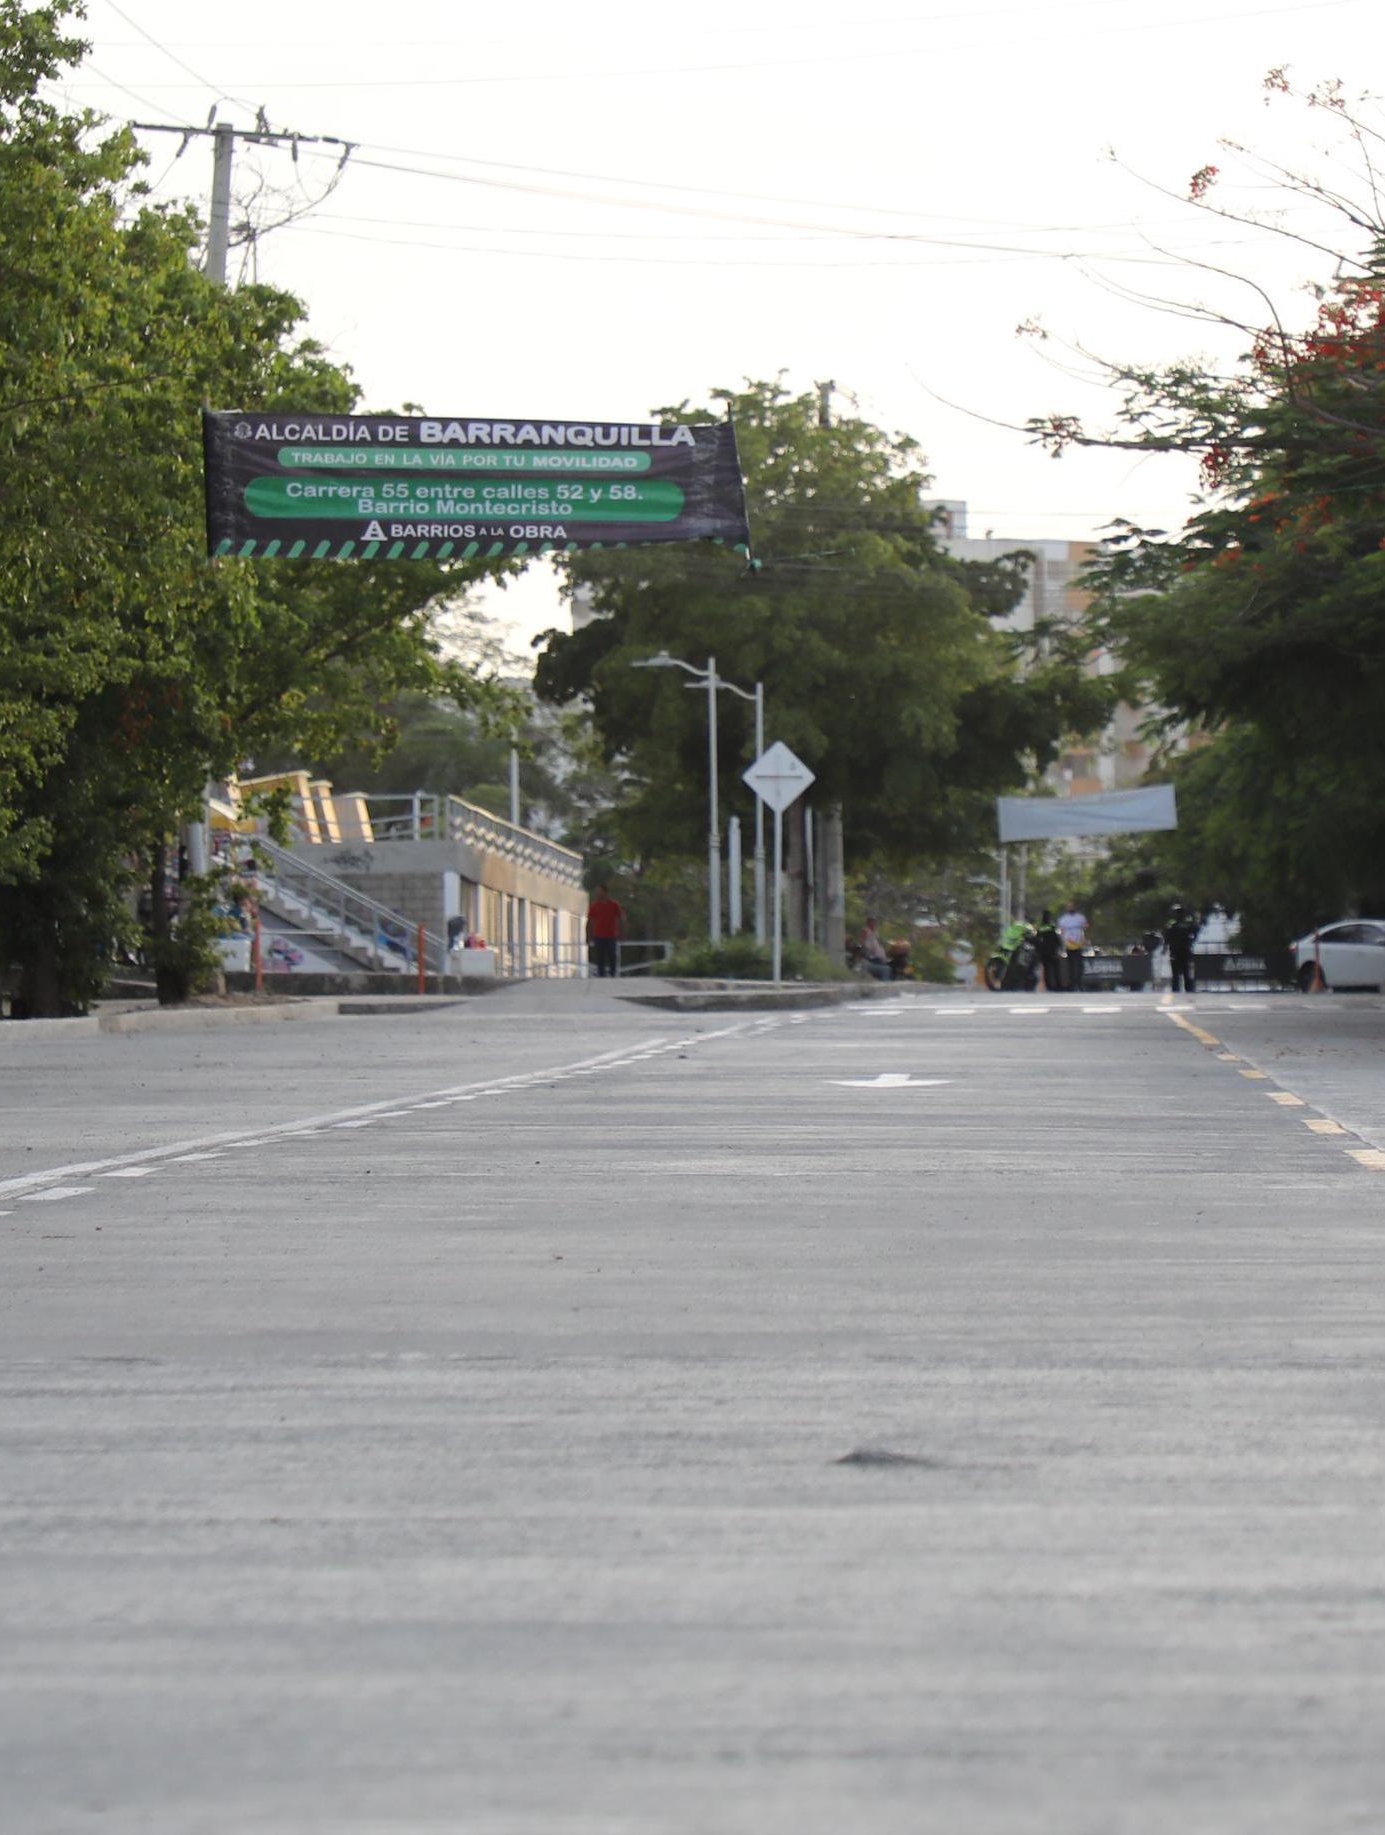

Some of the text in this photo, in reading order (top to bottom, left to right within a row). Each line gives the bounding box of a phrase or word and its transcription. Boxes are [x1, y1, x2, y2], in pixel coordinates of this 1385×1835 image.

[255, 421, 696, 447] ALCALDÍA DE BARRANQUILLA
[292, 451, 638, 468] TRABAJO EN LA VÍA POR TU MOVILIDAD
[286, 482, 643, 503] Carrera 55 entre calles 52 y 58.
[358, 499, 572, 516] Barrio Montecristo
[390, 523, 568, 539] BARRIOS A LA OBRA
